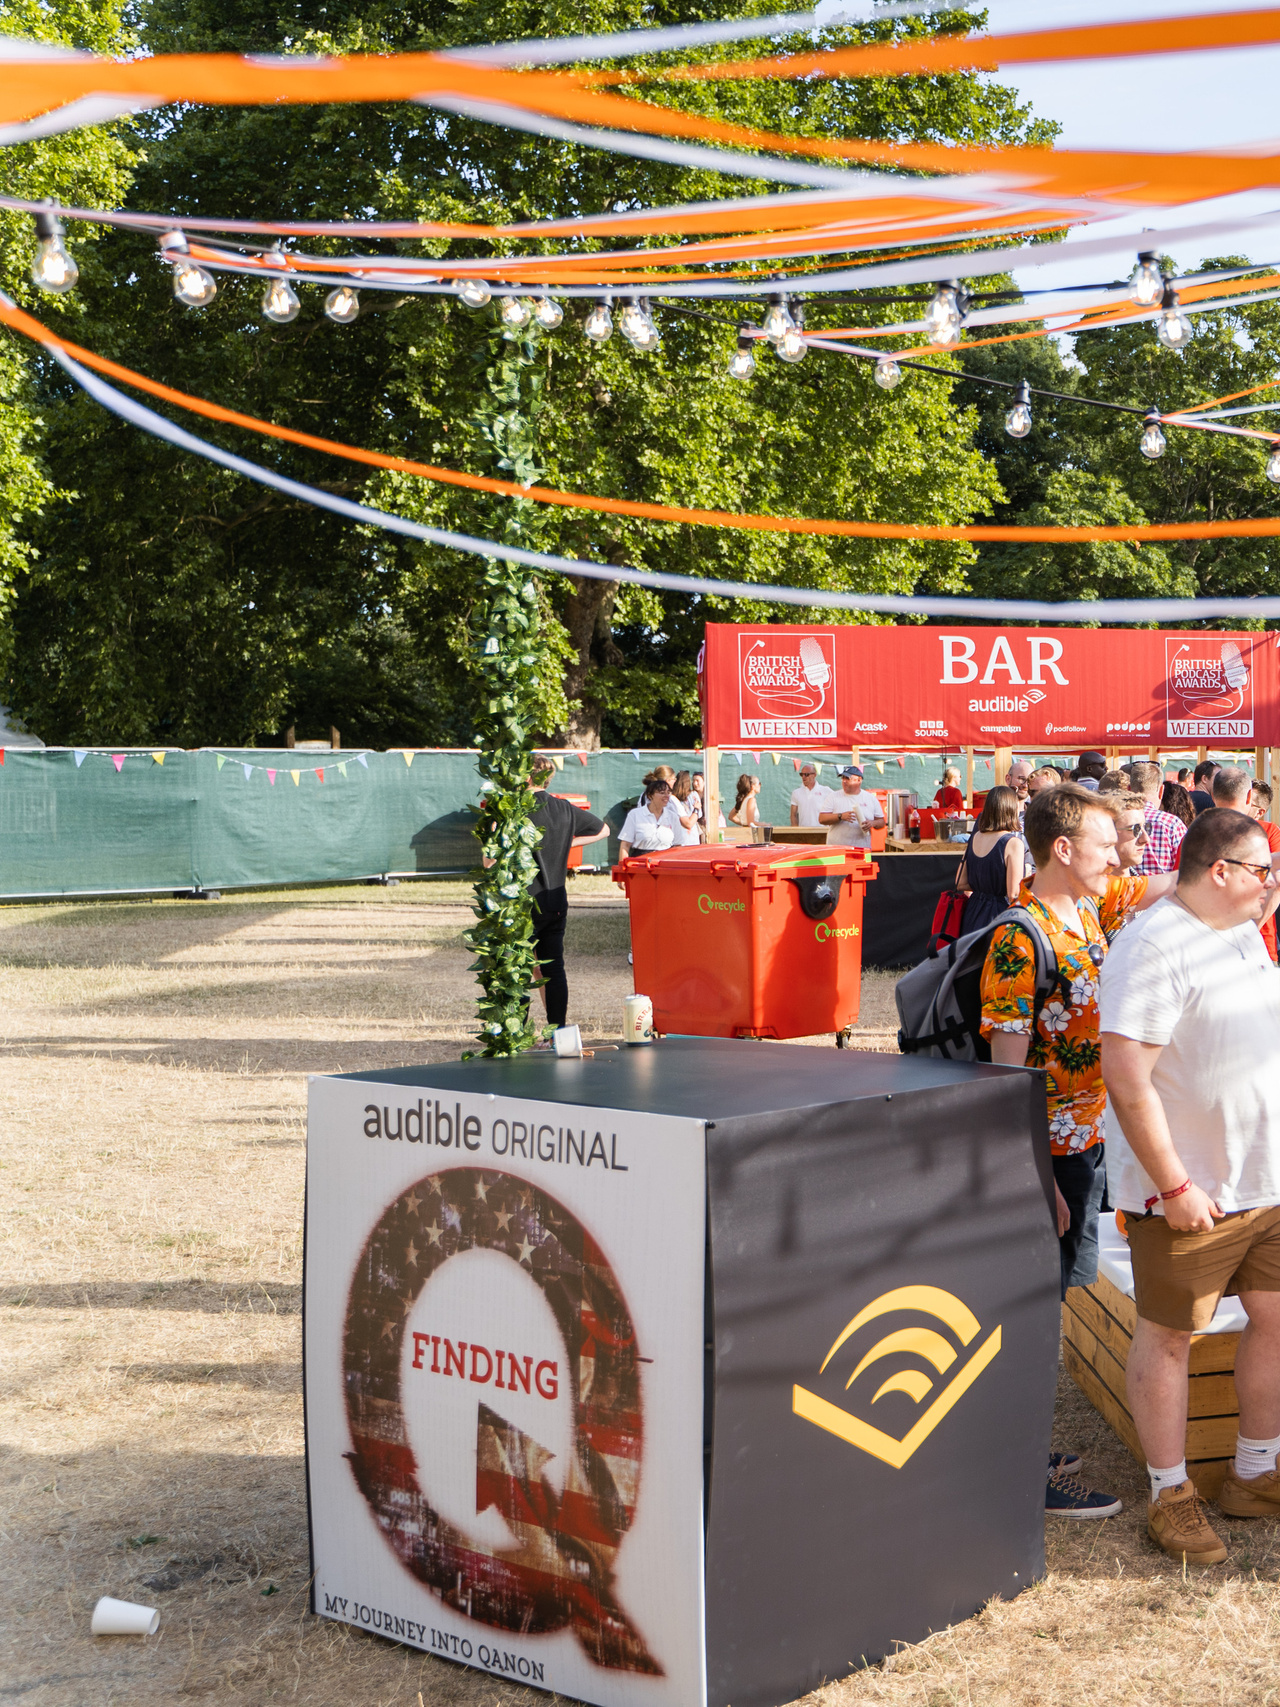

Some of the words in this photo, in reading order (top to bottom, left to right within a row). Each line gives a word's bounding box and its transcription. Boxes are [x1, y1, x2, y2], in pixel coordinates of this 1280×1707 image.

[748, 655, 800, 667] BRITISH
[938, 635, 1070, 686] BAR
[1174, 659, 1222, 670] BRITISH
[748, 666, 802, 676] PODCAST
[1174, 669, 1223, 679] PODCAST
[748, 675, 800, 686] AWARDS
[1175, 678, 1221, 688] AWARDS
[968, 695, 1029, 712] audible
[744, 721, 833, 736] WEEKEND
[914, 729, 949, 737] SOUNDS
[980, 724, 1022, 734] campaign
[1053, 725, 1087, 733] podfollow
[1106, 721, 1151, 733] podpod
[1170, 722, 1250, 736] WEEKEND
[714, 899, 745, 913] recycle
[831, 924, 859, 940] recycle
[362, 1099, 482, 1154] audible
[490, 1120, 629, 1173] ORIGINAL
[411, 1330, 560, 1401] FINDING
[324, 1592, 348, 1617] MY
[352, 1602, 427, 1643] JOURNEY
[430, 1628, 473, 1659] INTO
[477, 1644, 545, 1682] QANON
